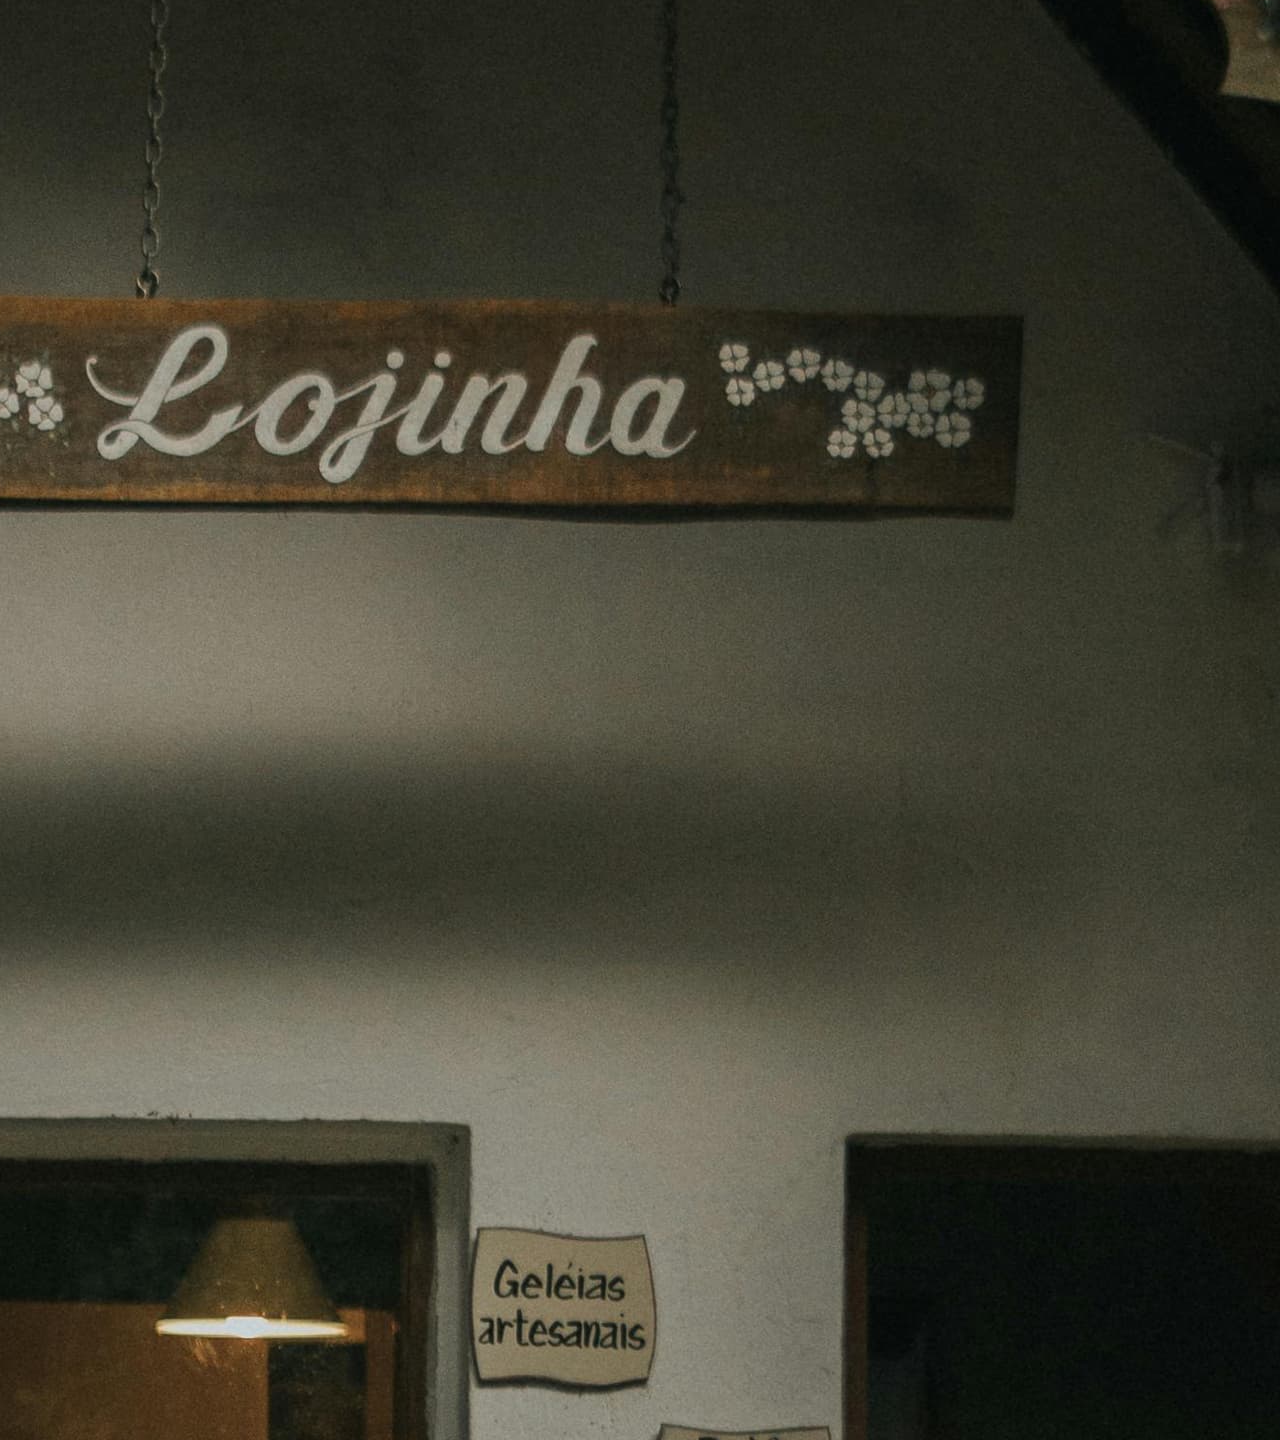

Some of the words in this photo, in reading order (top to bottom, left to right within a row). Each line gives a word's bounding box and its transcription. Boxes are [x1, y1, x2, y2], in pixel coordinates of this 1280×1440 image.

[85, 323, 696, 484] Lojinha
[493, 1259, 626, 1302] Geléias
[478, 1308, 646, 1351] artesanais
